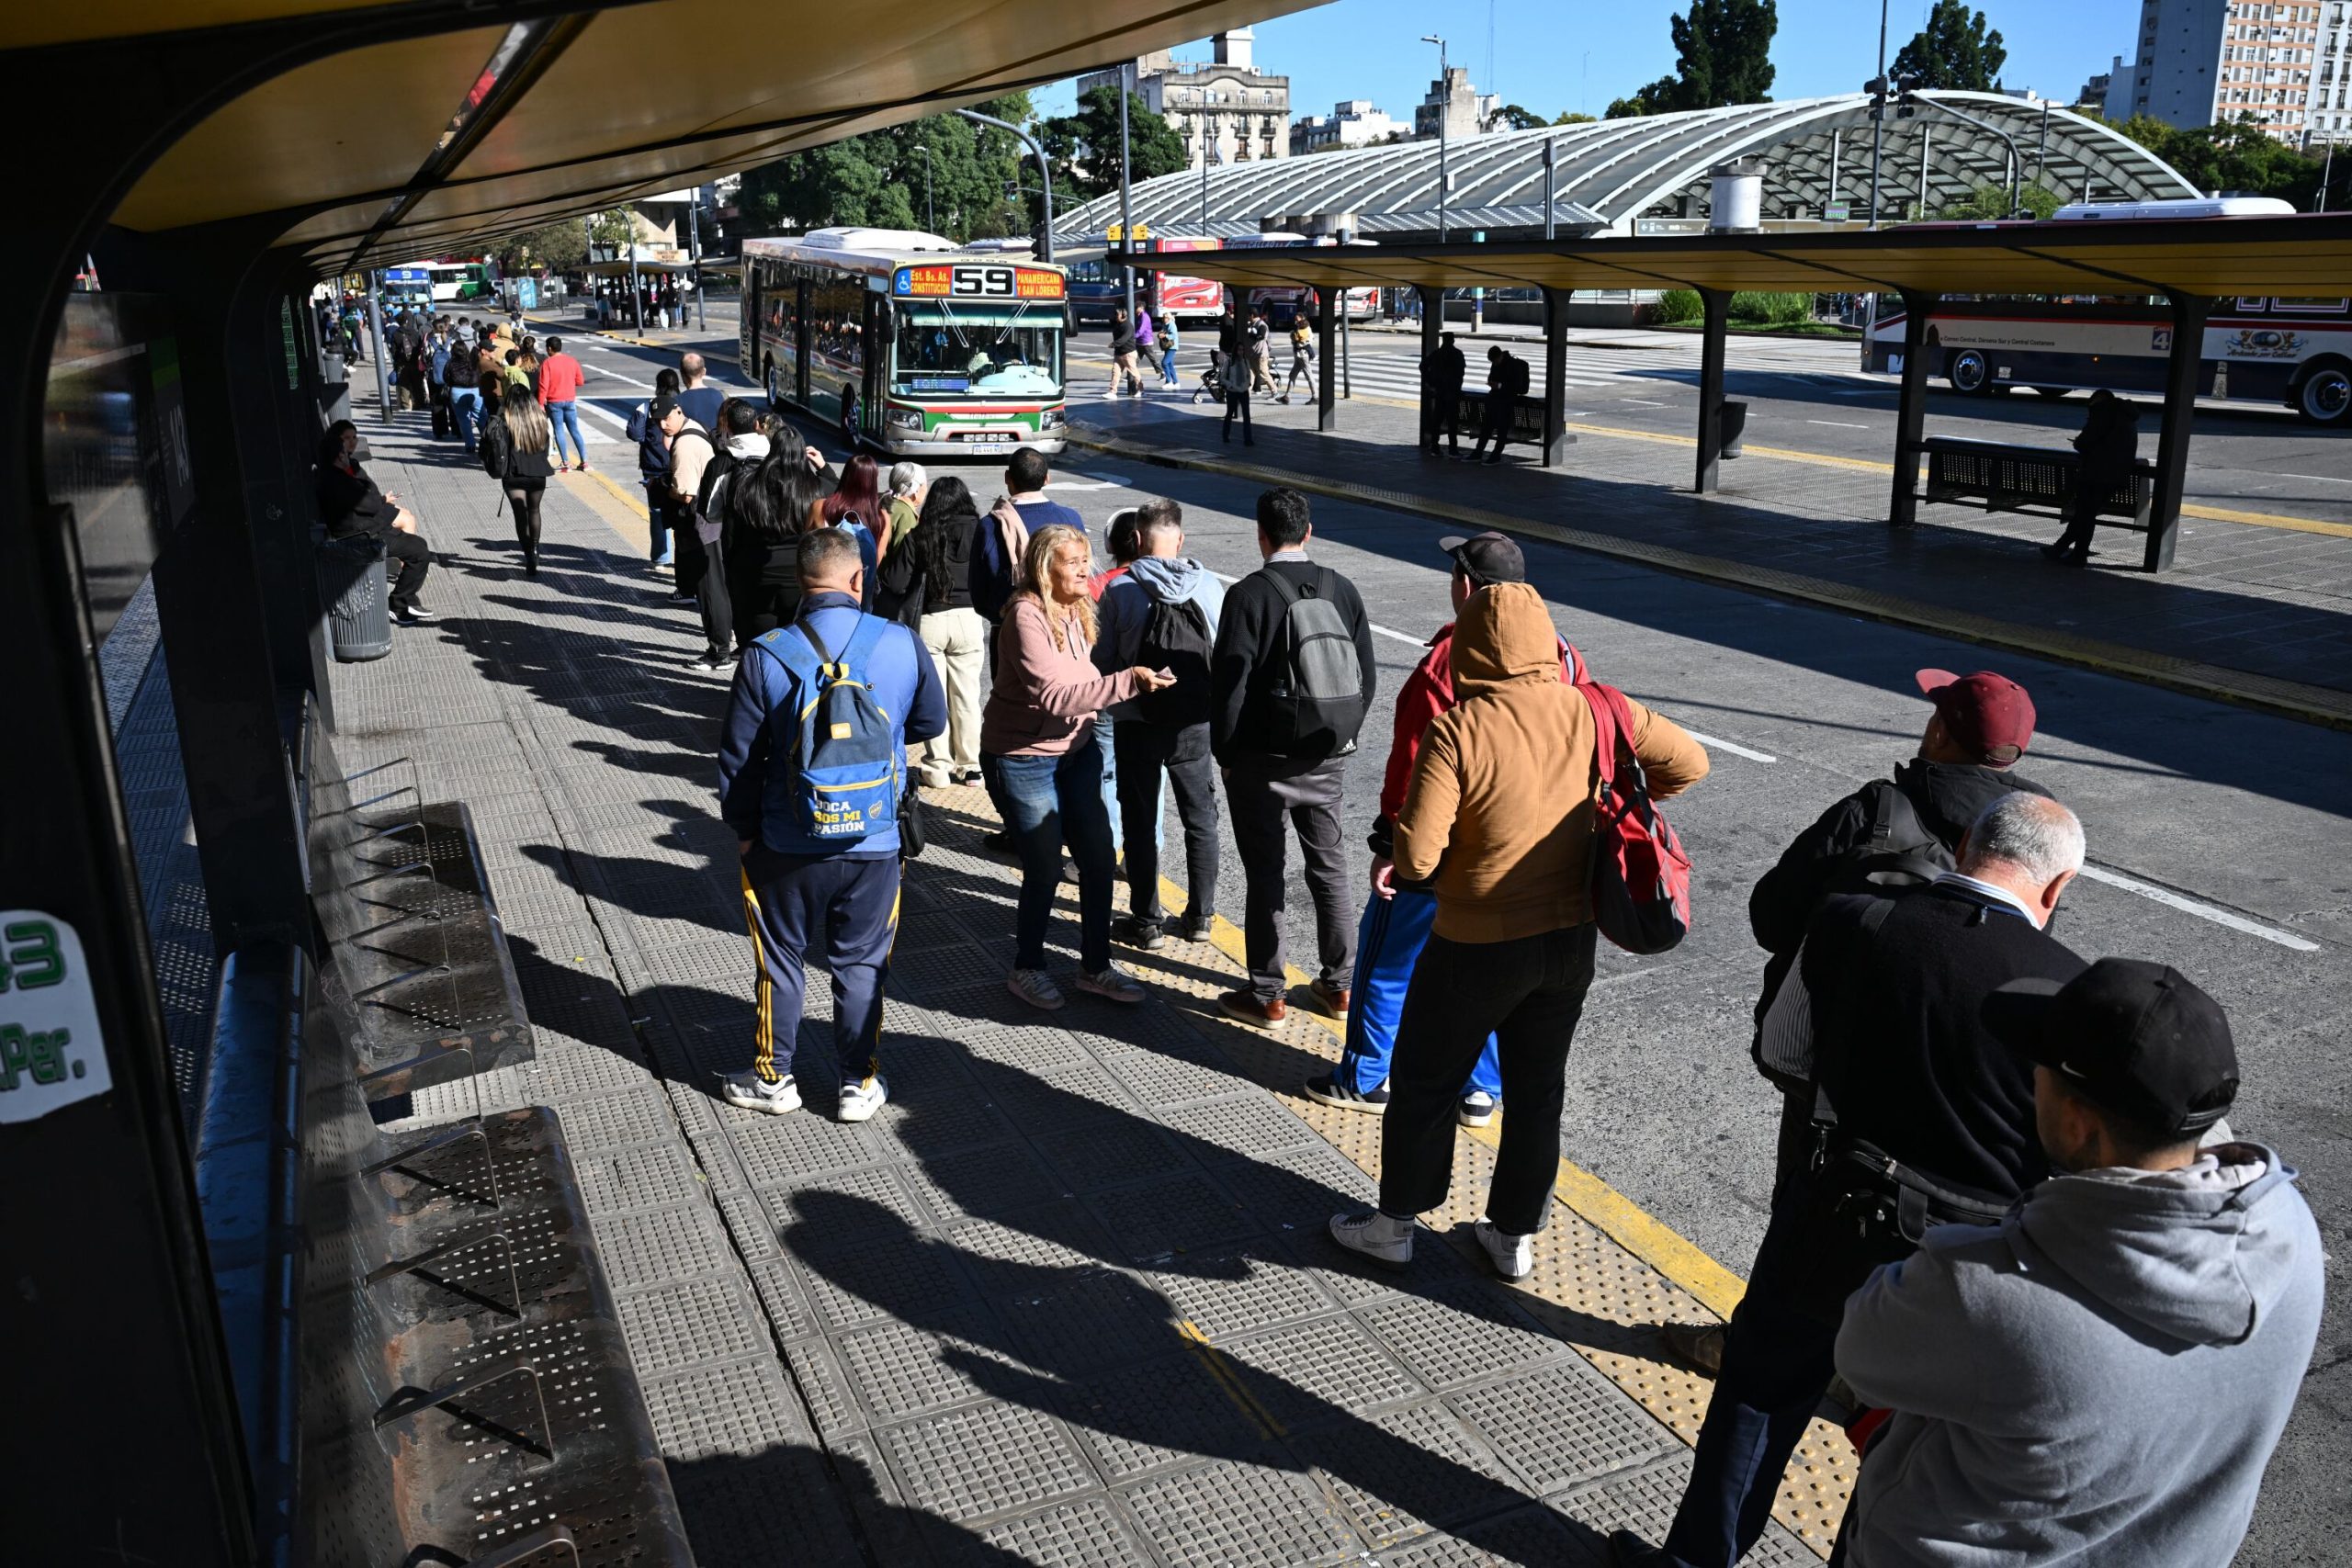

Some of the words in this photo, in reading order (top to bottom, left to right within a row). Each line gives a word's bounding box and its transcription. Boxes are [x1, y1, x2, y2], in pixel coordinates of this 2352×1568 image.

[910, 270, 923, 281] Est.
[925, 271, 935, 281] Bs.
[938, 272, 949, 282] As.
[955, 268, 1012, 294] 59
[1017, 273, 1059, 284] PANAMERICANA
[1017, 286, 1022, 296] Y
[1023, 285, 1035, 296] SAN
[1035, 285, 1060, 296] LORENZO
[2154, 333, 2168, 349] 4
[815, 800, 851, 812] BOCA
[814, 811, 840, 823] SOS
[842, 810, 861, 822] MI
[814, 821, 865, 834] PASIÓN
